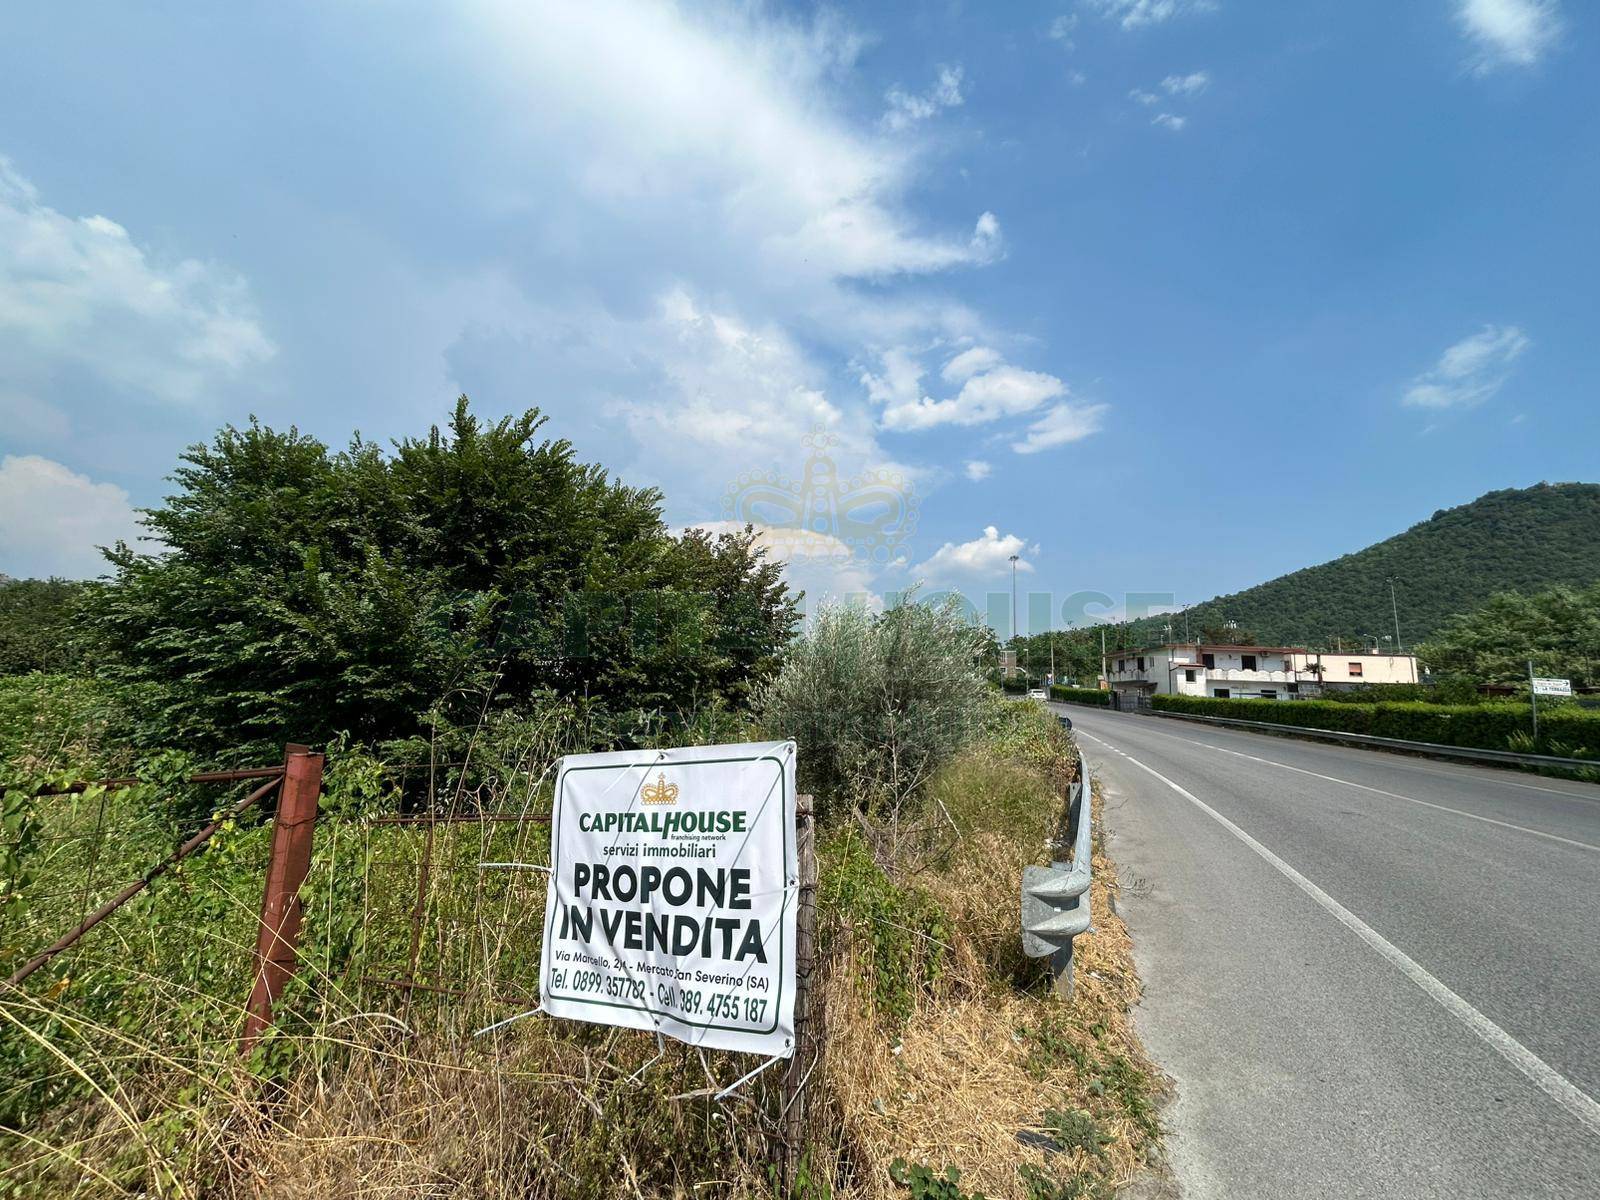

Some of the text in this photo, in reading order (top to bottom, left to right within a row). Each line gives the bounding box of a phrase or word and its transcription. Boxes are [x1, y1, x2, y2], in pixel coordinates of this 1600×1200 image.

[579, 811, 747, 839] CAPITALHOUSE
[671, 834, 700, 842] franchising
[603, 843, 716, 858] servizi immobiliari
[574, 862, 751, 910] PROPONE
[559, 904, 768, 964] IN VENDITA
[555, 950, 571, 962] Via
[573, 952, 611, 969] Marcello,
[637, 962, 674, 978] Mercato
[696, 971, 743, 987] Severino
[747, 975, 769, 992] (SA)
[551, 968, 568, 989] Tel.
[573, 970, 604, 994] 0899.
[606, 975, 645, 1000] 357782
[658, 983, 678, 1008] Cell.
[707, 992, 740, 1020] 4755
[744, 996, 768, 1023] 187
